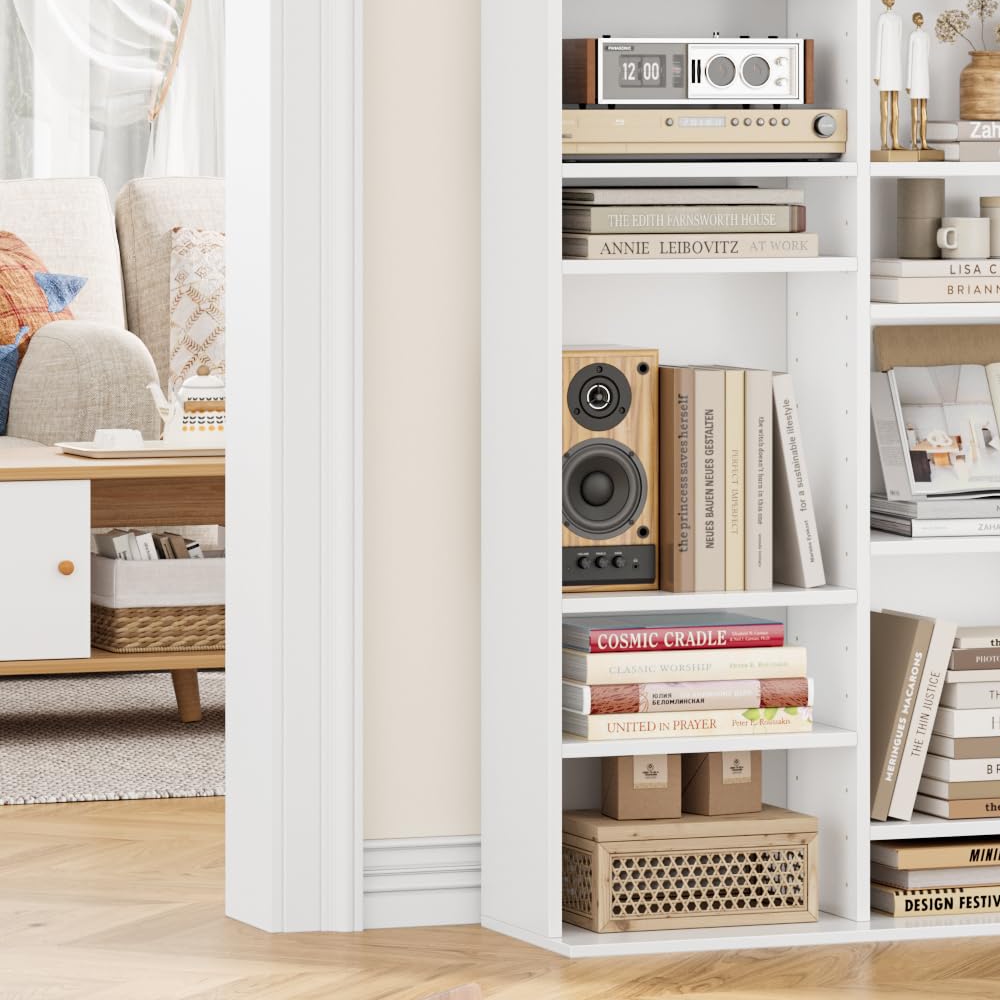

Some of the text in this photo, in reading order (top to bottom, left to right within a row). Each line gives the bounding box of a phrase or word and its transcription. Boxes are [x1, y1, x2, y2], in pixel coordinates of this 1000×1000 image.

[622, 63, 660, 81] 12 00
[608, 214, 776, 227] THE EDITH FARNSWORTH HOUSE
[600, 240, 808, 255] ANNIE LEIBOVITZ AT WORK
[950, 264, 982, 275] LISA
[782, 399, 795, 434] lifestyle
[788, 436, 804, 488] sustainable
[704, 409, 714, 549] NEUES BAUEN NEUES GESTALTEN
[799, 499, 808, 512] for
[977, 522, 1000, 531] ZAHA
[597, 631, 658, 650] COSMIC
[664, 630, 727, 647] CRADLE
[884, 651, 923, 782] MERINGUES MACARONS
[911, 671, 941, 758] THE THIN JUSTICE
[607, 719, 717, 734] UNITED IN PRAYER
[904, 897, 954, 912] DESIGN
